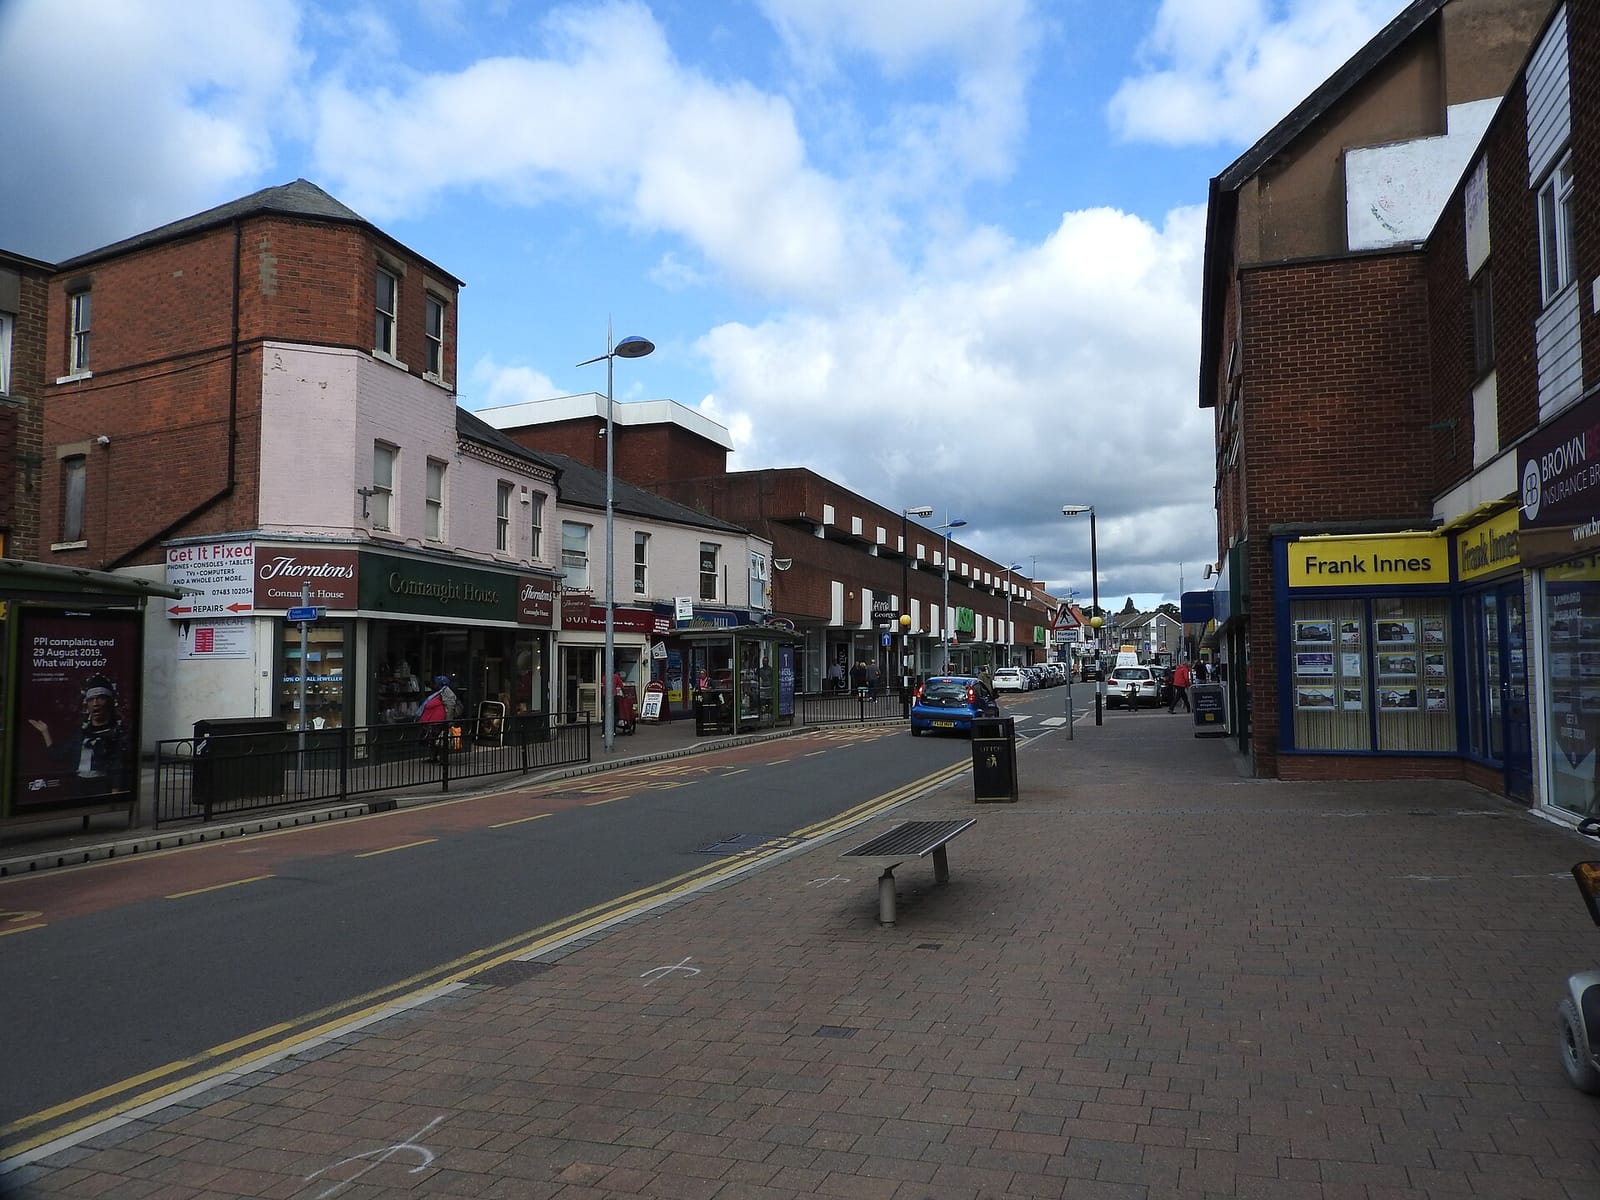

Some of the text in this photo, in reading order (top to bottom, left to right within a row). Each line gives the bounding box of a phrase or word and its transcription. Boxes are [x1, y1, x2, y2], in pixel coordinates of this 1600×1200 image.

[1542, 432, 1586, 483] BROWN
[169, 542, 252, 563] Get It Fixed
[1462, 532, 1489, 574] Frank
[167, 563, 189, 571] PHONES
[193, 560, 223, 569] CONSOLES
[260, 556, 354, 580] Thorntons
[1305, 554, 1432, 575] Frank Innes
[200, 568, 235, 577] COMPUTERS
[317, 588, 345, 599] House
[389, 572, 499, 604] Connaught House
[521, 584, 553, 602] Thorntons
[193, 605, 224, 613] REPAIRS
[714, 617, 728, 628] HILL
[33, 637, 115, 648] PPI complaints end
[33, 648, 103, 659] 29 August 2019.
[33, 658, 108, 669] What will you do?
